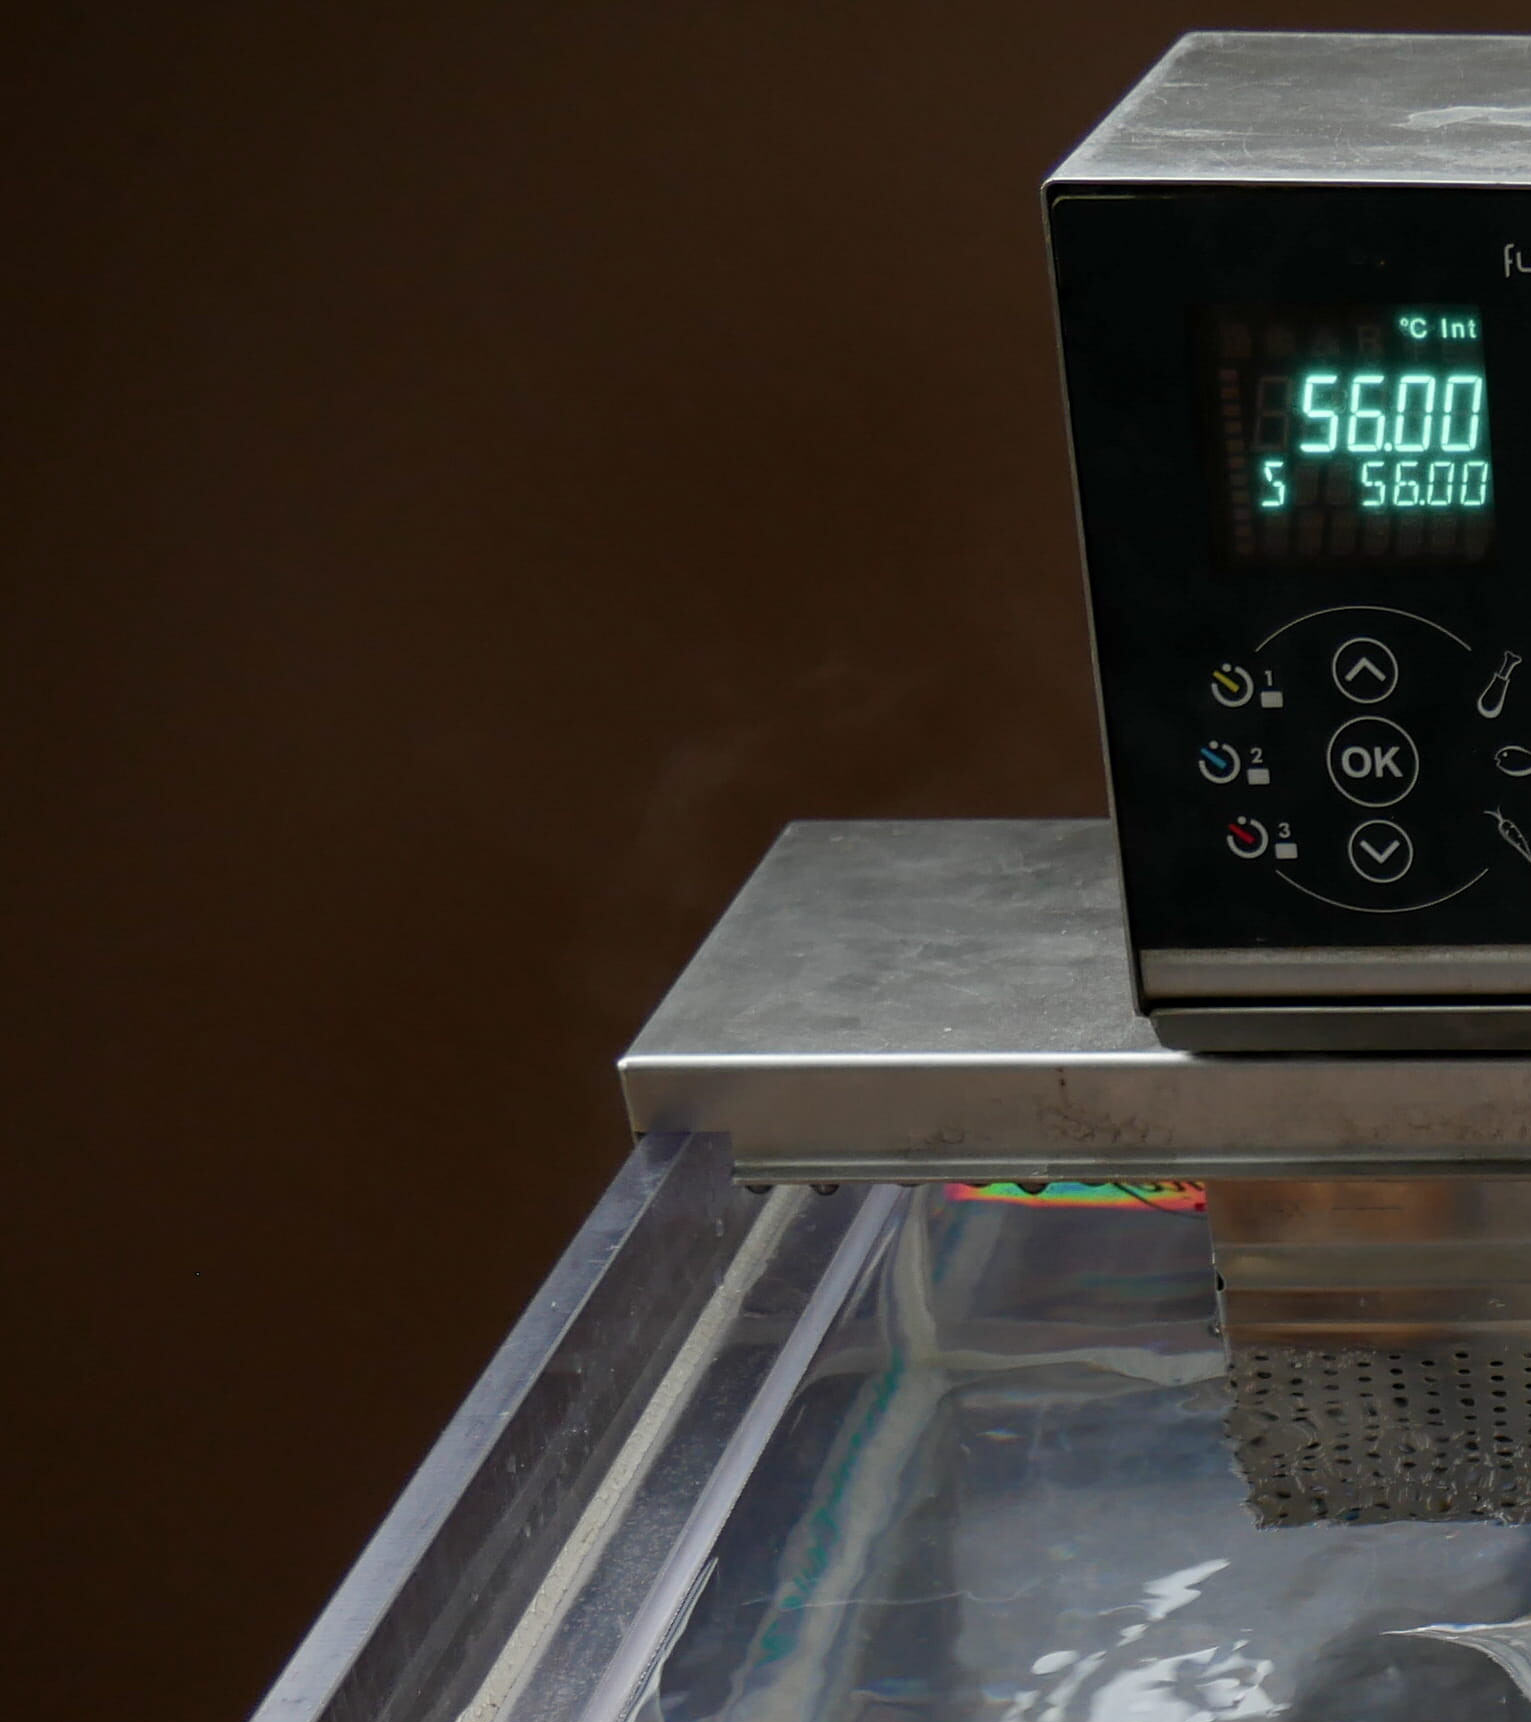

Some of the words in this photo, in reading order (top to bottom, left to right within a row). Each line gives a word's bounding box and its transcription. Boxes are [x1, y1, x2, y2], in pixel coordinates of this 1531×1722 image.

[1440, 317, 1478, 339] Int
[1299, 374, 1484, 453] 56.00
[1360, 460, 1489, 507] 56.00
[1263, 670, 1274, 687] 1
[1250, 747, 1265, 766] 2
[1340, 745, 1404, 779] OK
[1278, 822, 1291, 839] 3
